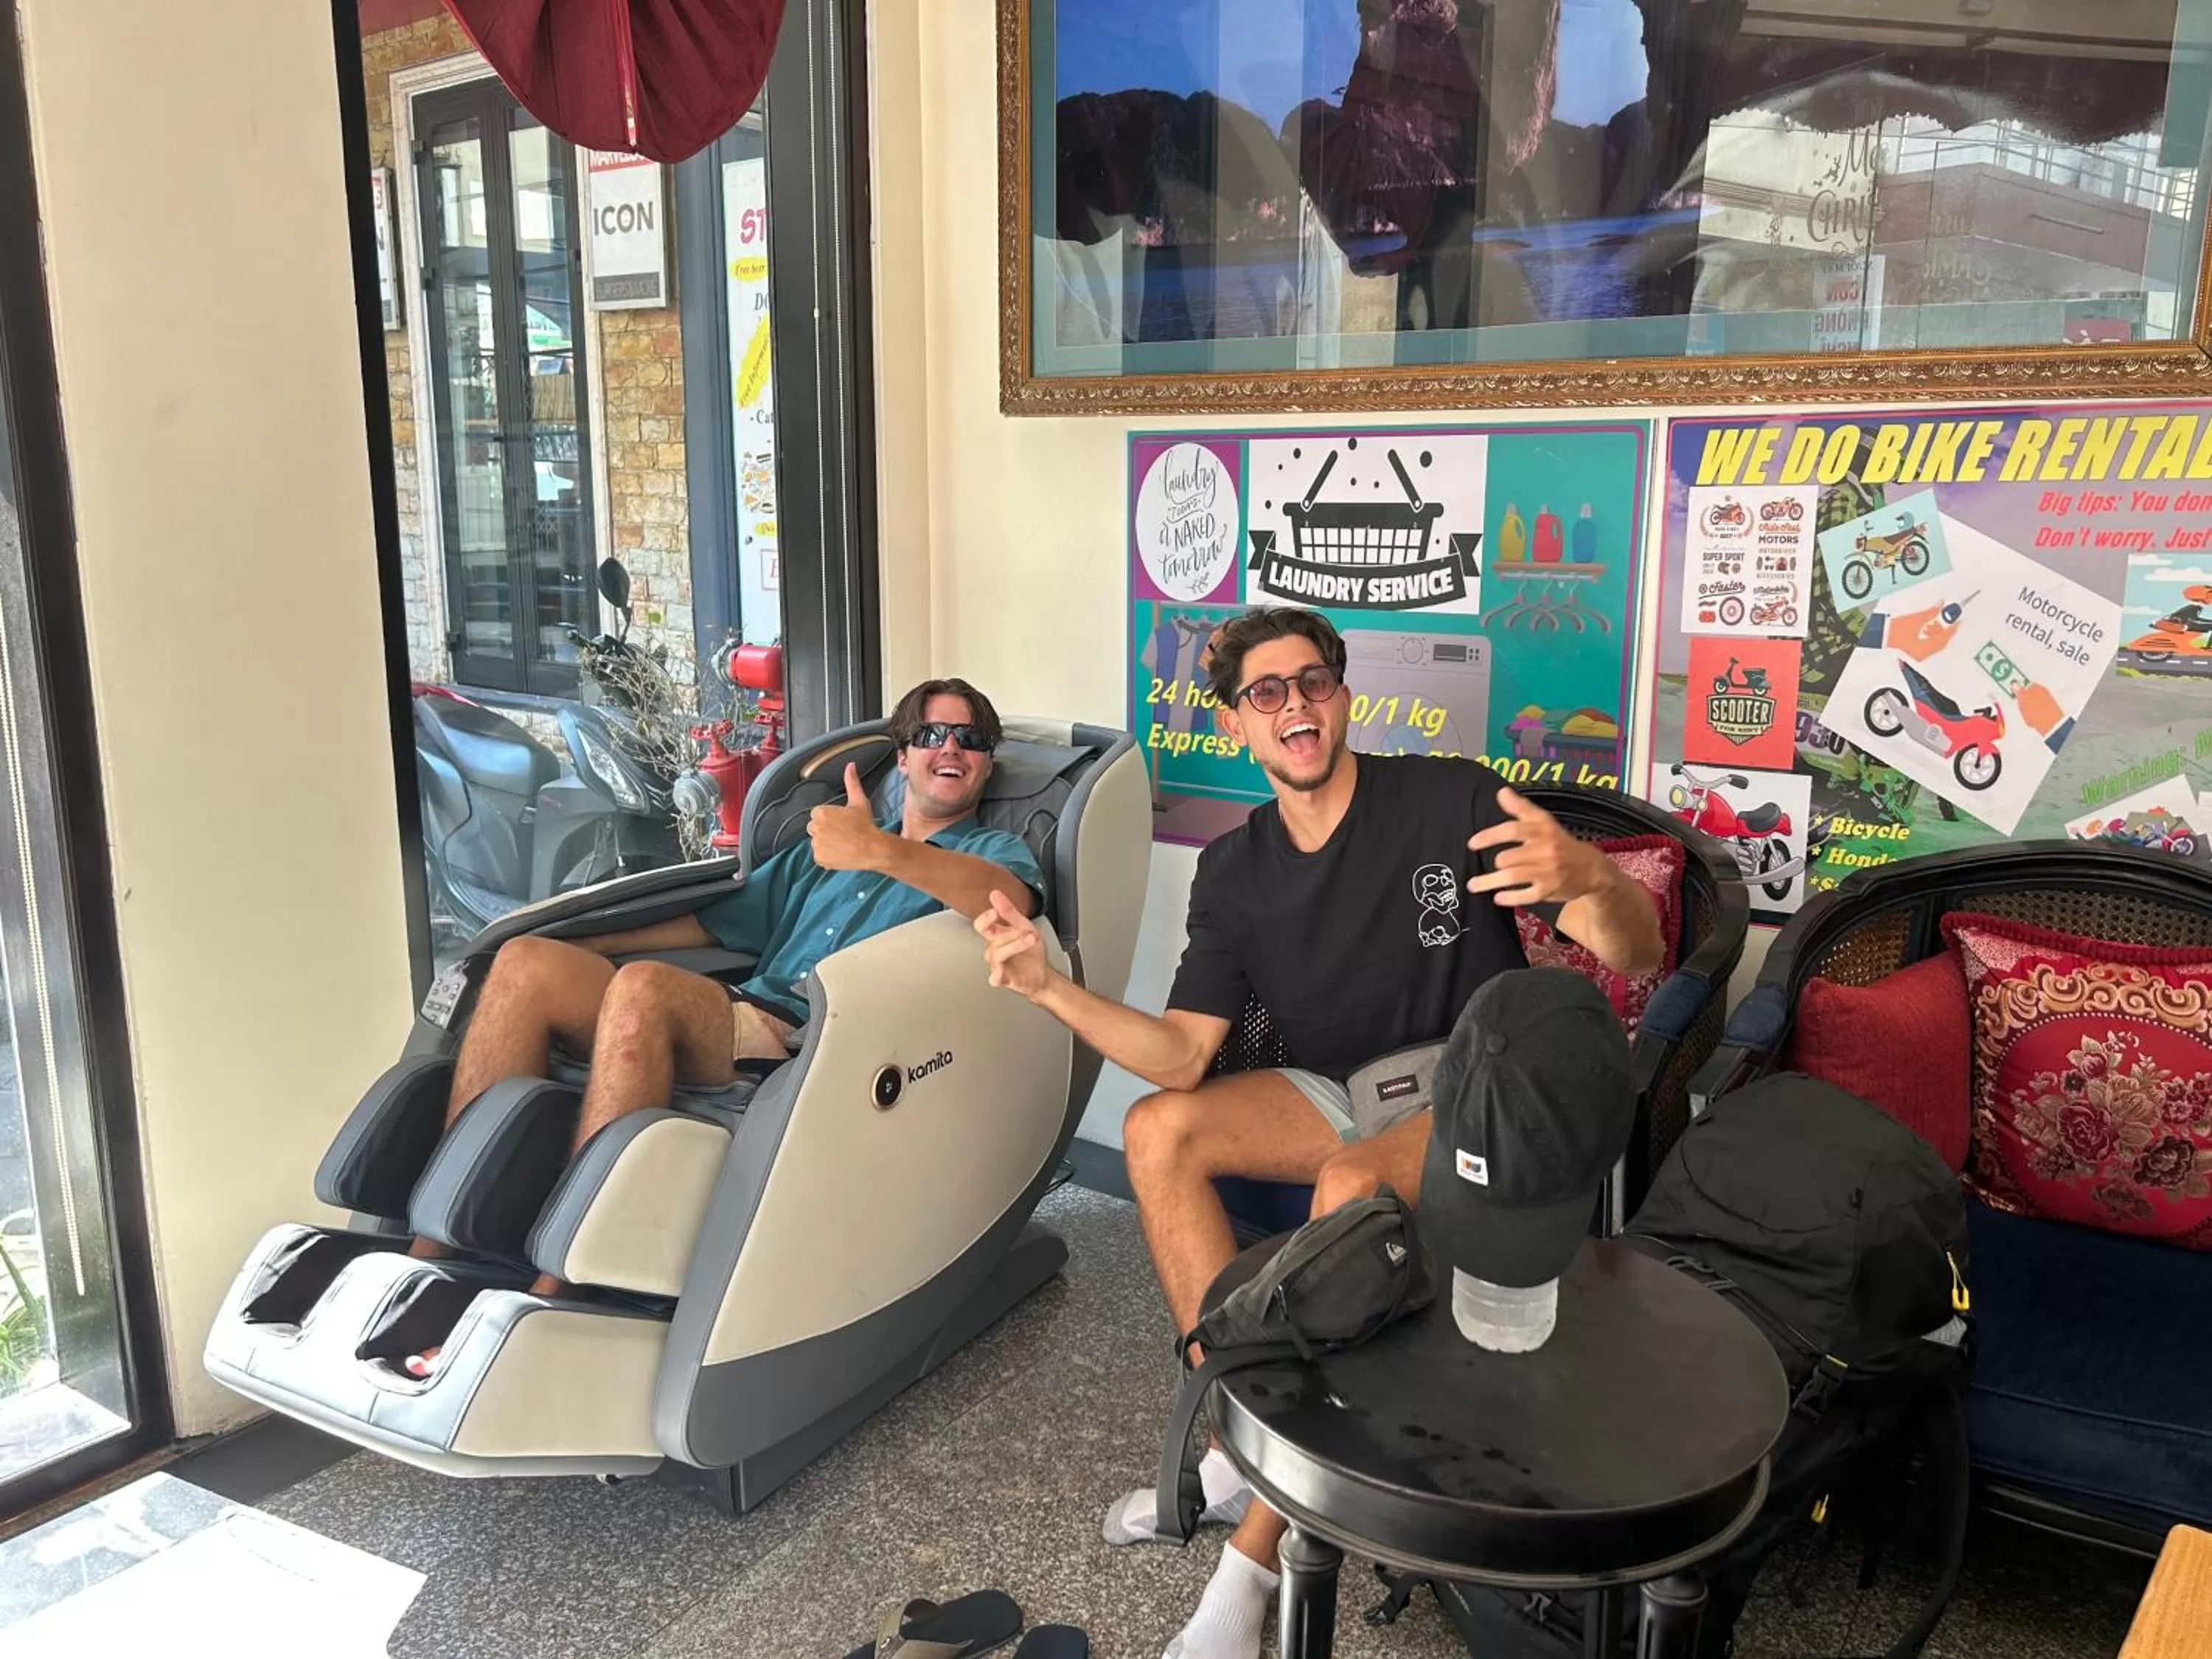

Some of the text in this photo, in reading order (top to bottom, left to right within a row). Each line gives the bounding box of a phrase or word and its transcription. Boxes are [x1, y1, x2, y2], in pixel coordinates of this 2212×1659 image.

[594, 201, 654, 236] ICON
[1695, 428, 1781, 485] WE
[1780, 425, 1860, 484] DO
[1860, 421, 2003, 484] BIKE
[1164, 448, 1217, 509] laundry
[2037, 491, 2072, 516] Big
[2077, 490, 2124, 515] tips:
[2130, 490, 2169, 512] You
[1175, 513, 1216, 552] NAKED
[2035, 527, 2090, 547] Don't
[2094, 530, 2157, 552] worry.
[1158, 524, 1227, 584] tomorrow
[1268, 561, 1455, 602] LAUNDRY SERVICE
[2017, 586, 2104, 643] Motorcycle
[2005, 613, 2090, 665] rental, sale
[1146, 678, 1178, 704] 24
[1407, 698, 1447, 737] kg
[1712, 699, 1770, 723] SCOOTER
[1147, 723, 1240, 758] Express
[1829, 817, 1911, 840] Bicycle
[1826, 848, 1899, 868] Hond
[908, 1051, 953, 1084] kamita
